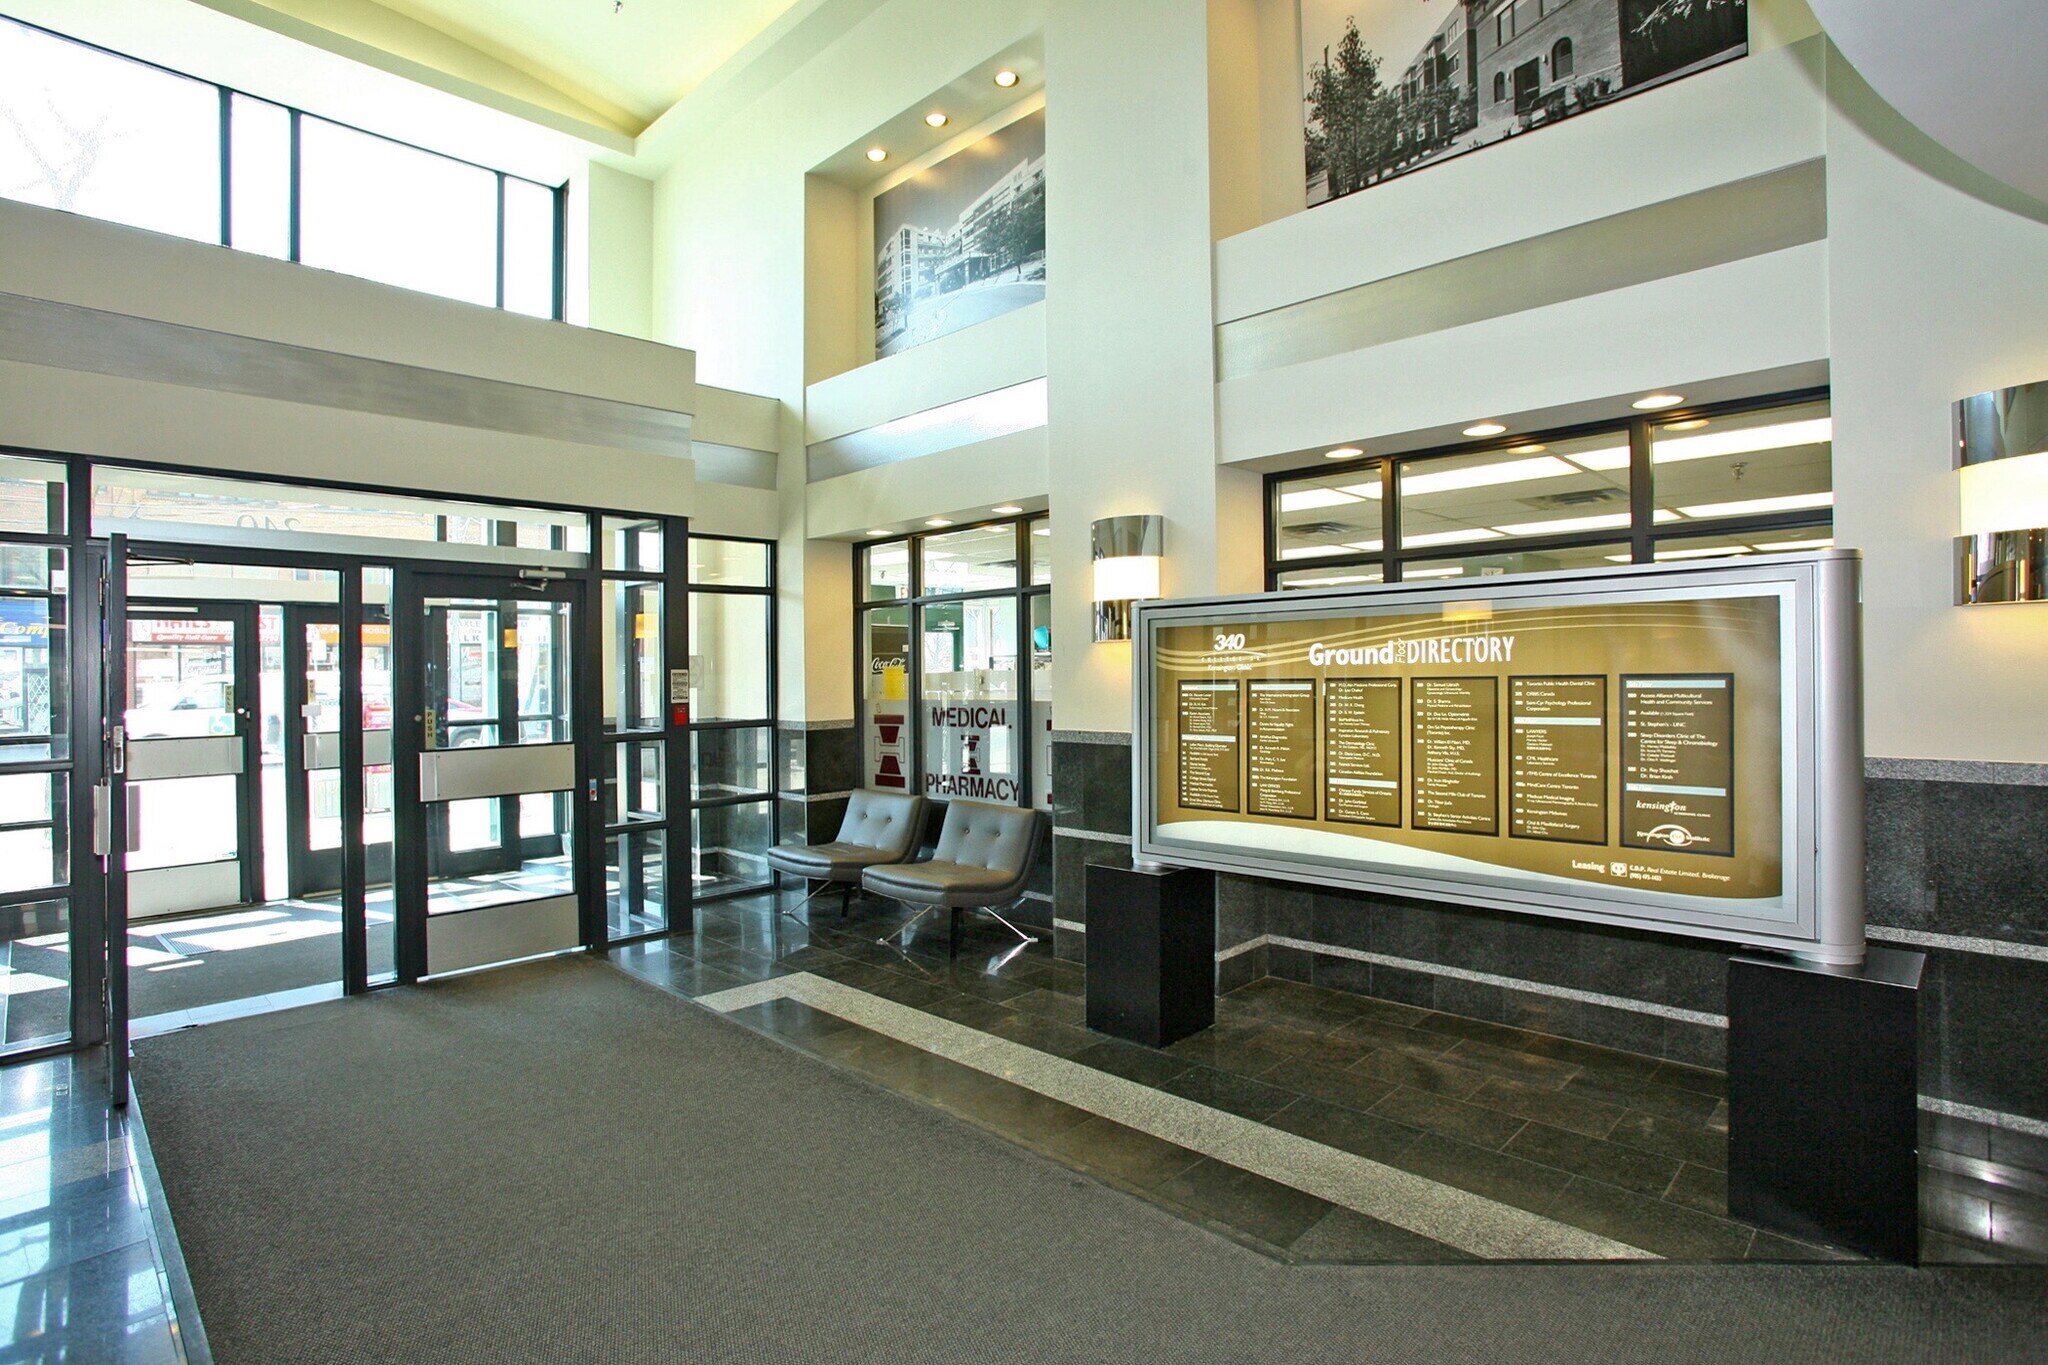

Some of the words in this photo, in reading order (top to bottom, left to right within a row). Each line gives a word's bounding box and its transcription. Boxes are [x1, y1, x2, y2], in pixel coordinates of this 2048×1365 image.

[1214, 633, 1246, 652] 340
[1308, 642, 1394, 666] Ground
[1394, 637, 1408, 664] Floor
[1407, 636, 1515, 664] DIRECTORY
[931, 707, 1012, 729] MEDICAL
[925, 773, 1019, 801] PHARMACY
[1636, 800, 1687, 813] kensington
[1572, 860, 1606, 873] Leasing
[1701, 873, 1731, 882] Brokerage
